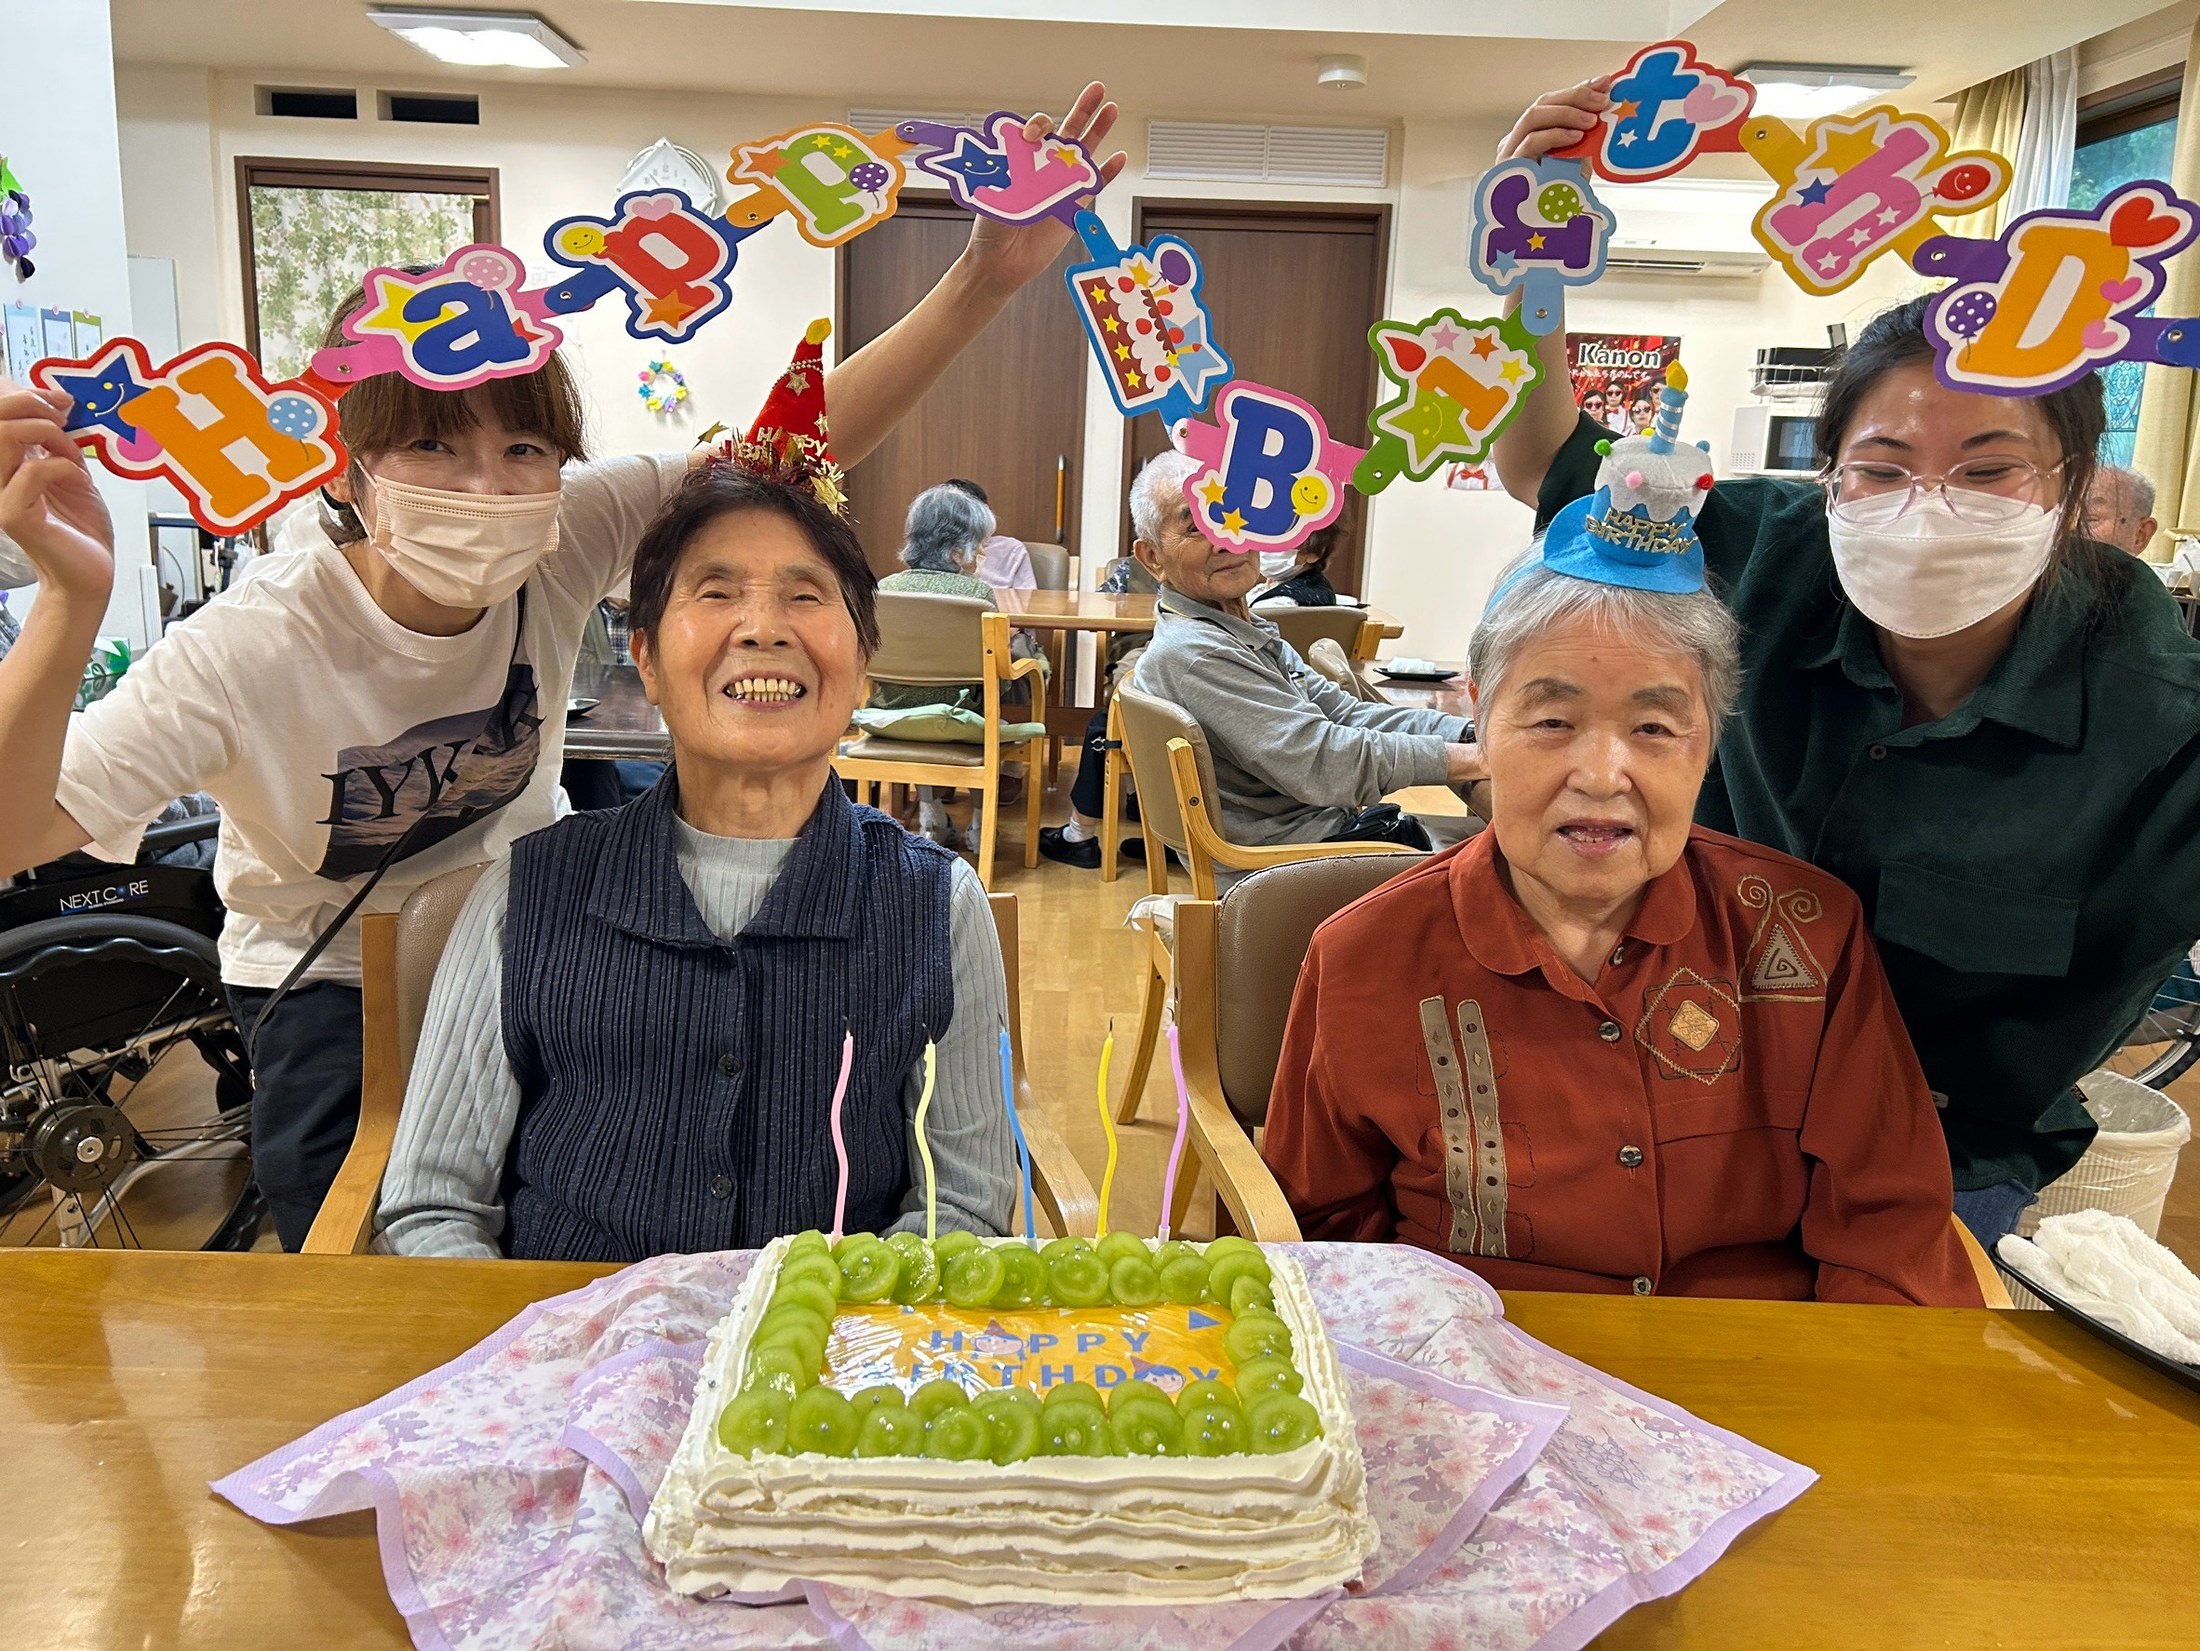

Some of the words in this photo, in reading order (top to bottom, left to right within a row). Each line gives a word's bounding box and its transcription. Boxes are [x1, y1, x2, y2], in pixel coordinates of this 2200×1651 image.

[1579, 343, 1660, 369] Kanon
[1584, 514, 1699, 555] BIRTHDAY
[1603, 507, 1687, 539] HAPPY
